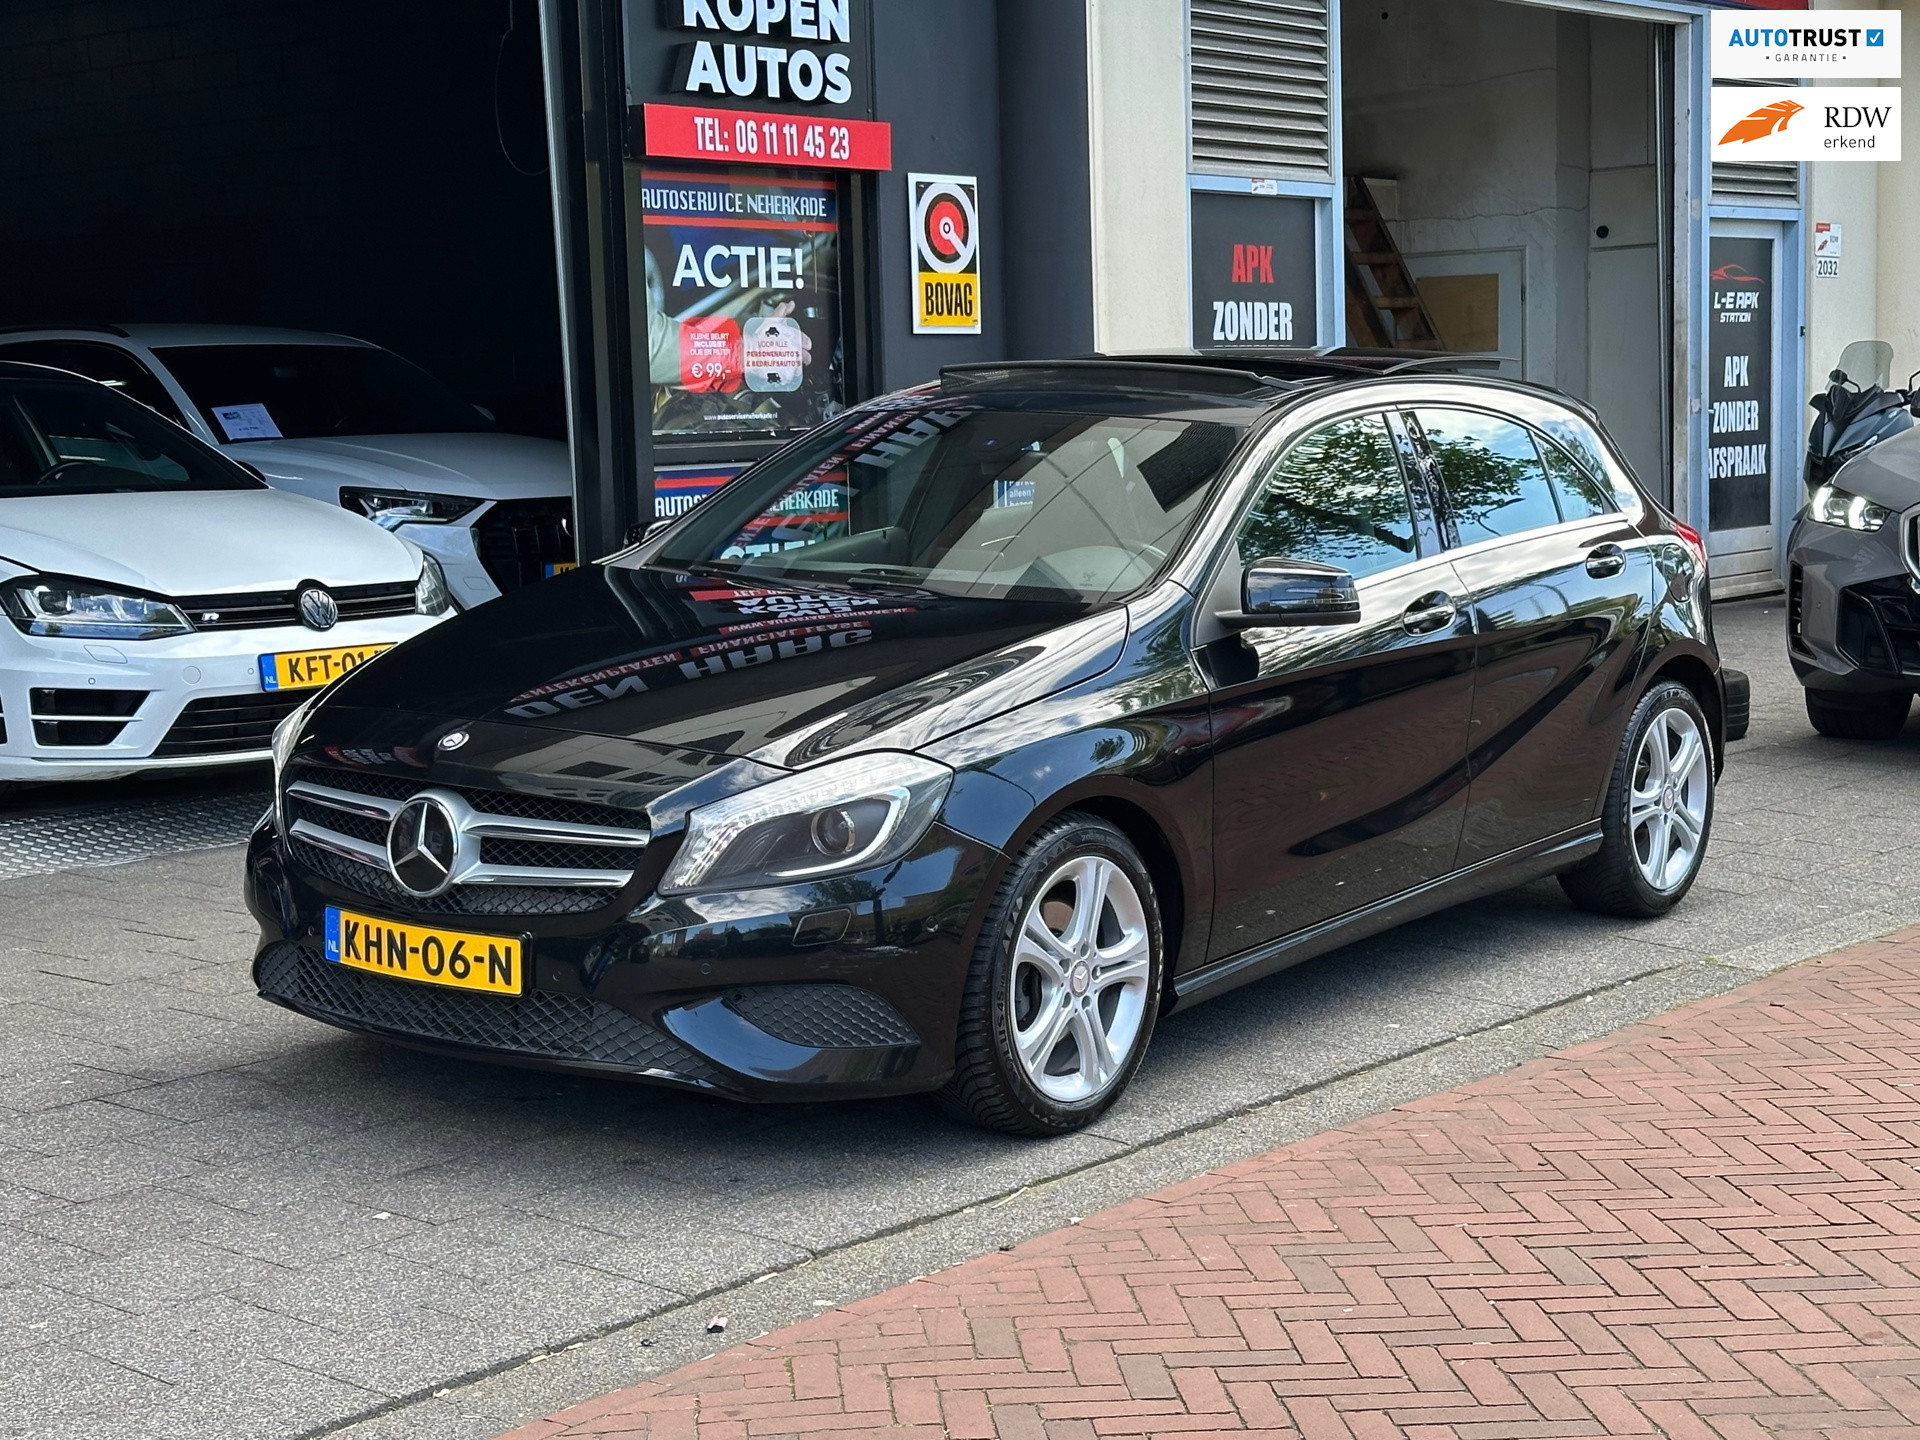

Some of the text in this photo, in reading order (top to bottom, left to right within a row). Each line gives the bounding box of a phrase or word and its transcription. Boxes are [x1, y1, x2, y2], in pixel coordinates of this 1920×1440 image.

[683, 0, 850, 43] KOPEN
[686, 40, 851, 104] AUTOS
[694, 116, 850, 160] TEL: 06 11 11 45 23
[641, 188, 827, 217] AUTOSERVICE NEHERKADE
[672, 244, 804, 289] ACTIE!
[1231, 244, 1274, 283] APK
[1817, 260, 1838, 276] 2032
[925, 282, 973, 317] BOVAG
[1735, 292, 1760, 309] APK
[1213, 301, 1292, 340] ZONDER
[1719, 312, 1751, 323] STATION
[691, 363, 731, 379] € 99,-
[1724, 356, 1749, 387] APK
[1713, 400, 1759, 433] ZONDER
[1708, 444, 1766, 479] AFSPRAAK
[265, 675, 277, 685] NL
[328, 919, 513, 986] NL KHN-06-N
